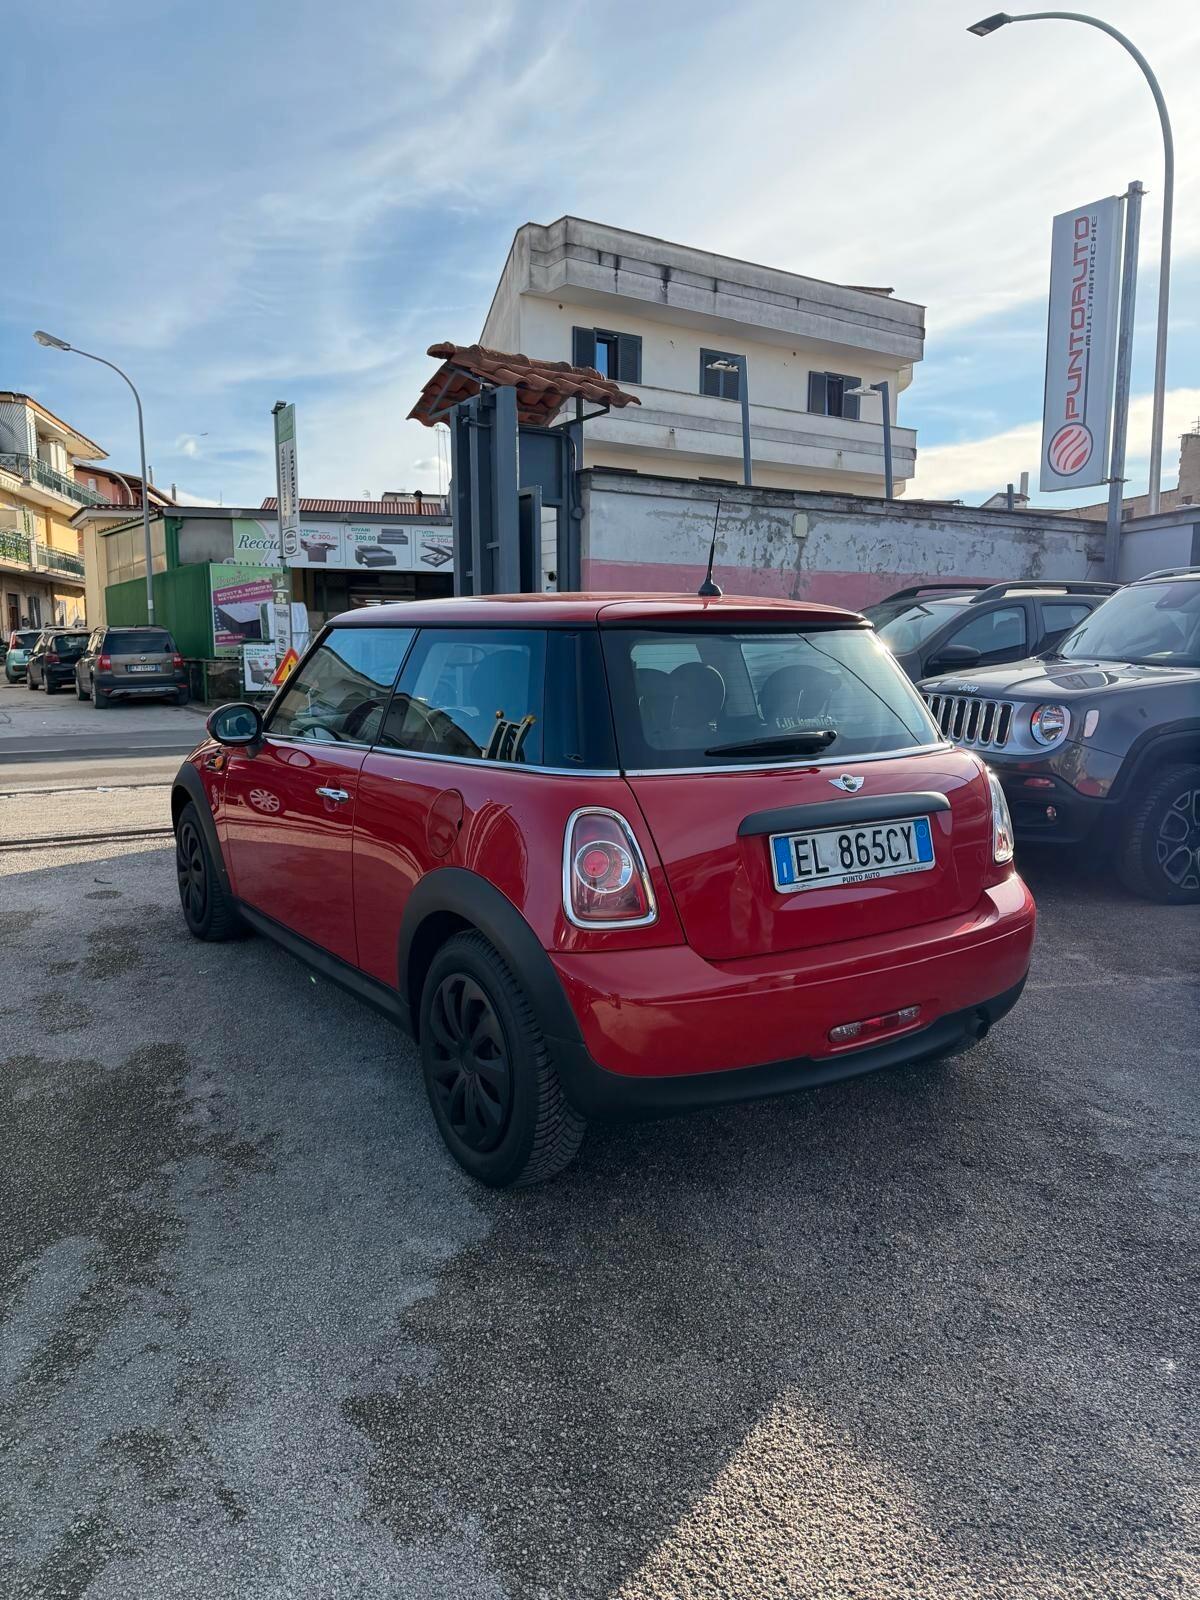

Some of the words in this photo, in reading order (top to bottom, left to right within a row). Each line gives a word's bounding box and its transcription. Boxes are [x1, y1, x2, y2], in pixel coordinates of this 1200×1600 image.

[1065, 215, 1090, 420] PUNTOAUTO
[1085, 215, 1099, 347] MULTIMARCHE
[793, 838, 830, 876] EL
[838, 825, 913, 869] 865CY
[842, 873, 863, 884] PUNTO
[864, 871, 881, 880] AUTO
